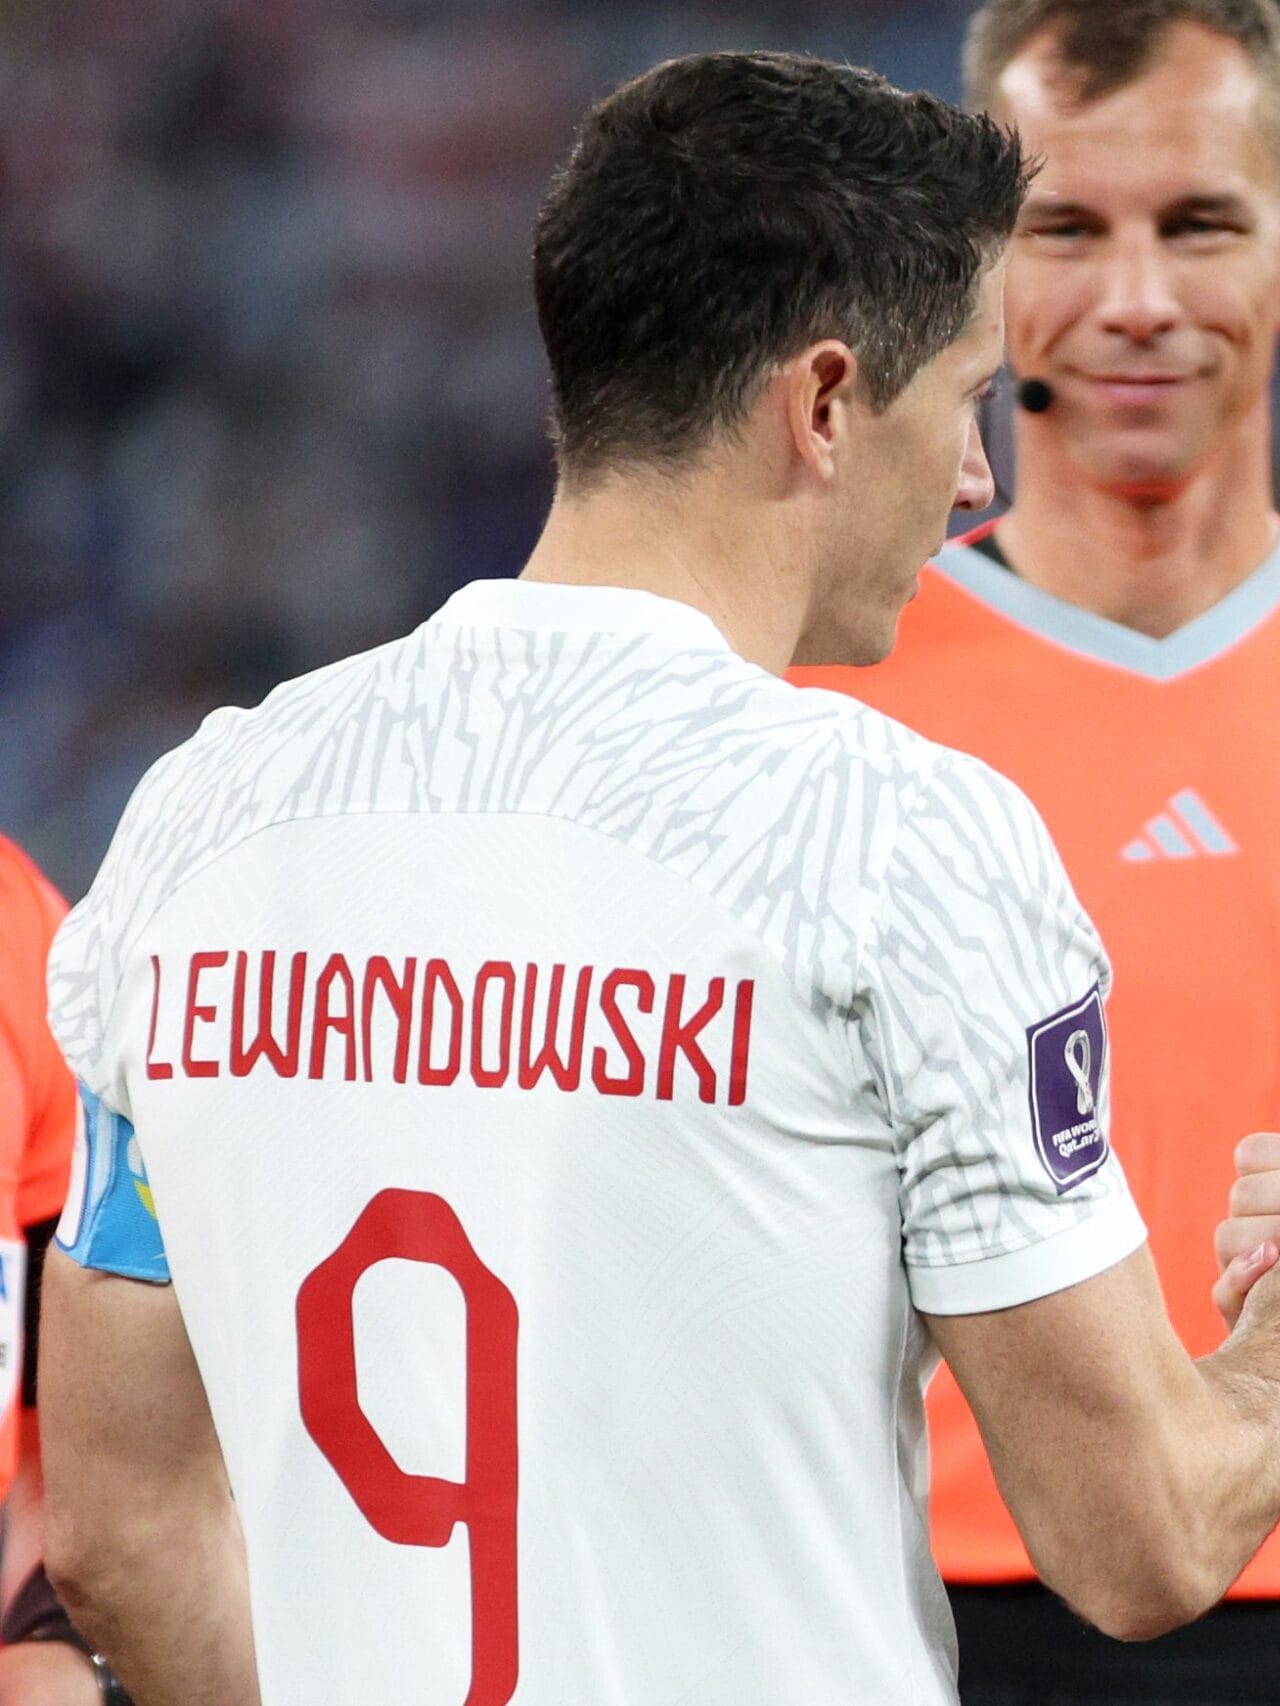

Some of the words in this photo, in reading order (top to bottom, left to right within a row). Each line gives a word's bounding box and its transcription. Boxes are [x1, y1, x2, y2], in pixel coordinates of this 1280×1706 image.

[145, 949, 755, 1107] LEWANDOWSKI
[1052, 1128, 1072, 1147] FIFA
[296, 1187, 519, 1706] 9
